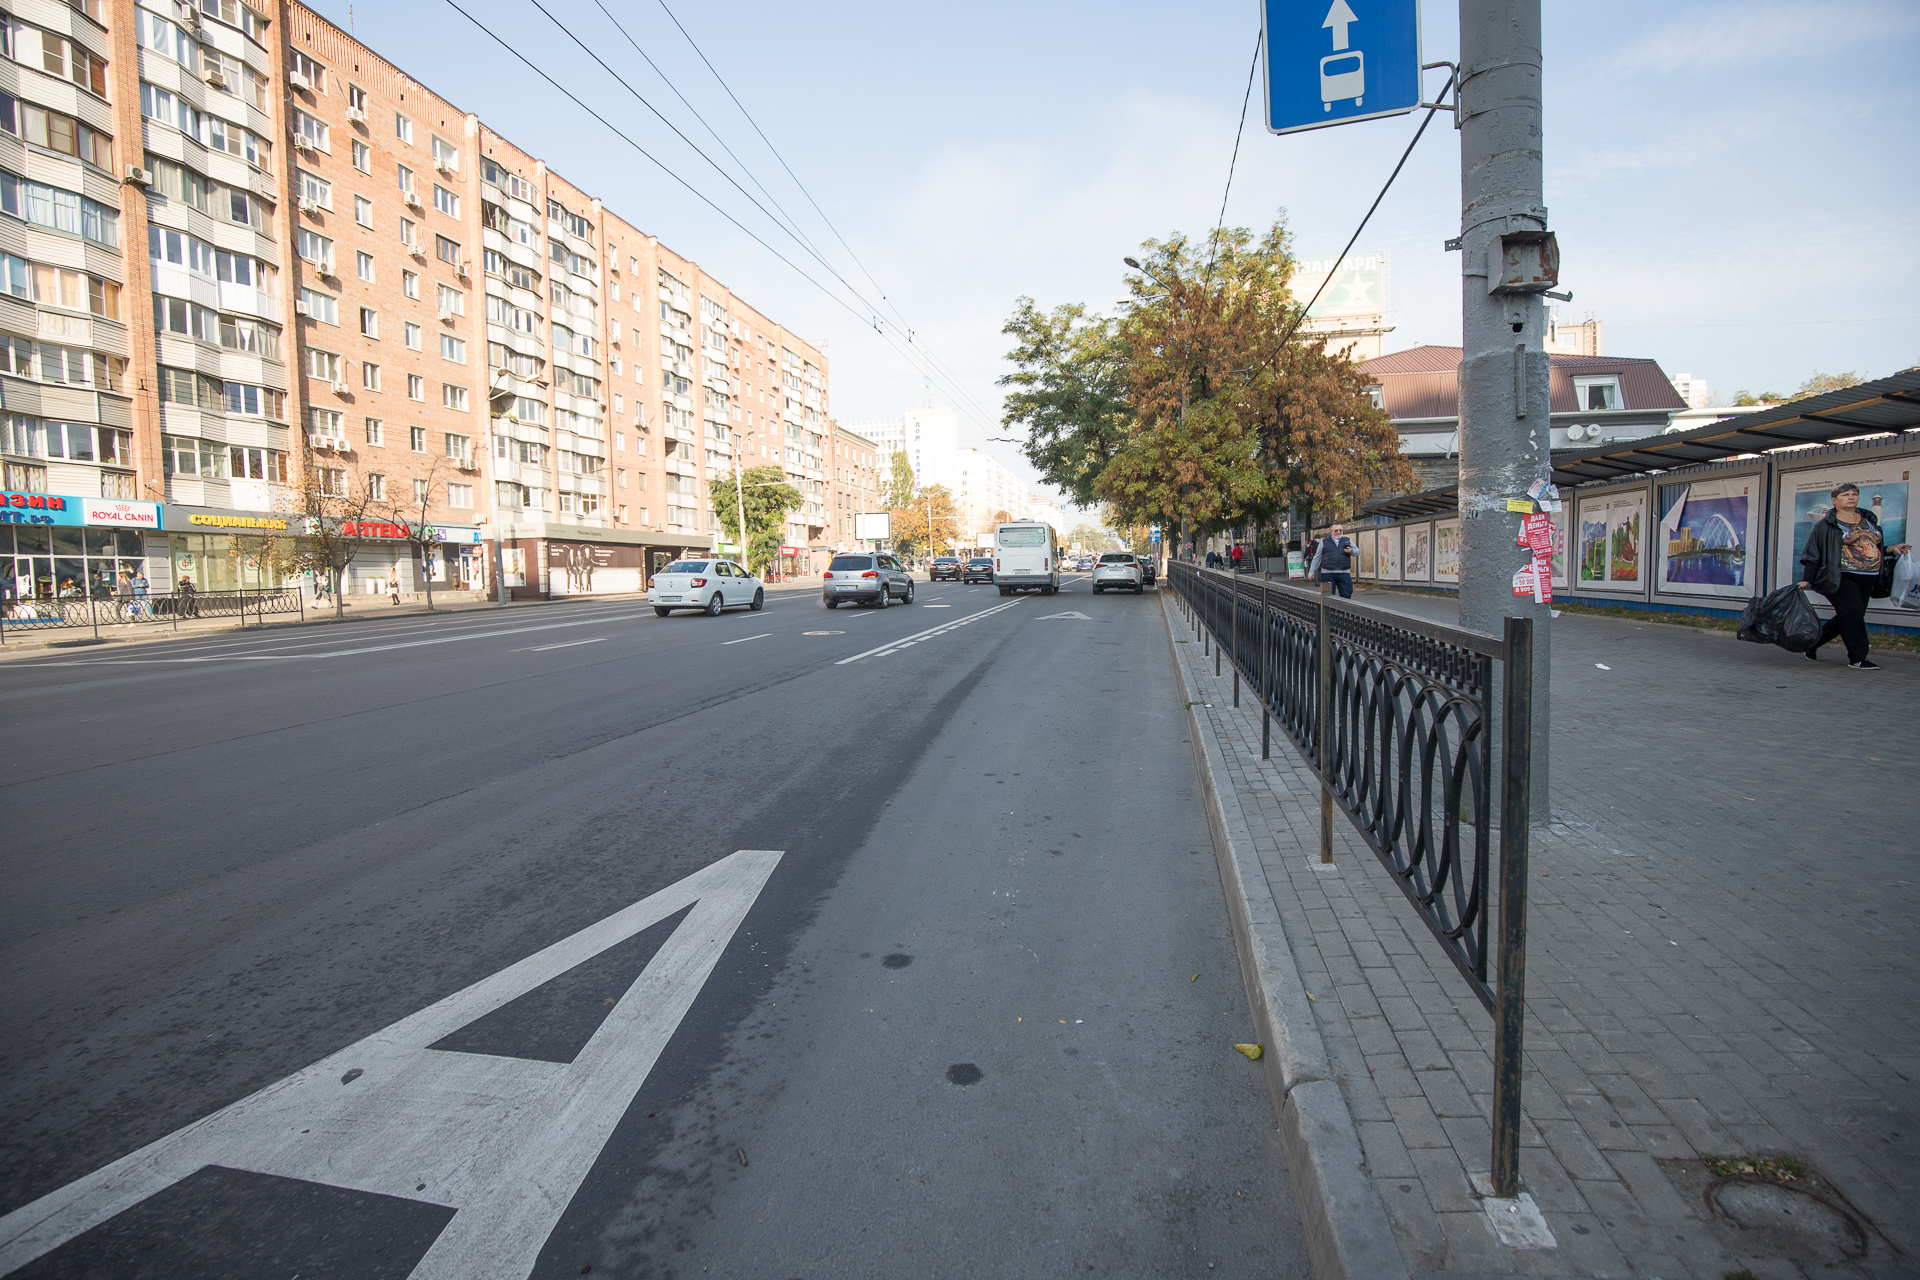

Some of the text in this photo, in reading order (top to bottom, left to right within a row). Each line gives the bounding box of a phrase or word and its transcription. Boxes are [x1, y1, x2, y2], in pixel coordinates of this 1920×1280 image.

[1294, 256, 1377, 275] ВАНАРД
[92, 511, 154, 522] ROYAL CANIN
[343, 521, 411, 538] АПТЕКА
